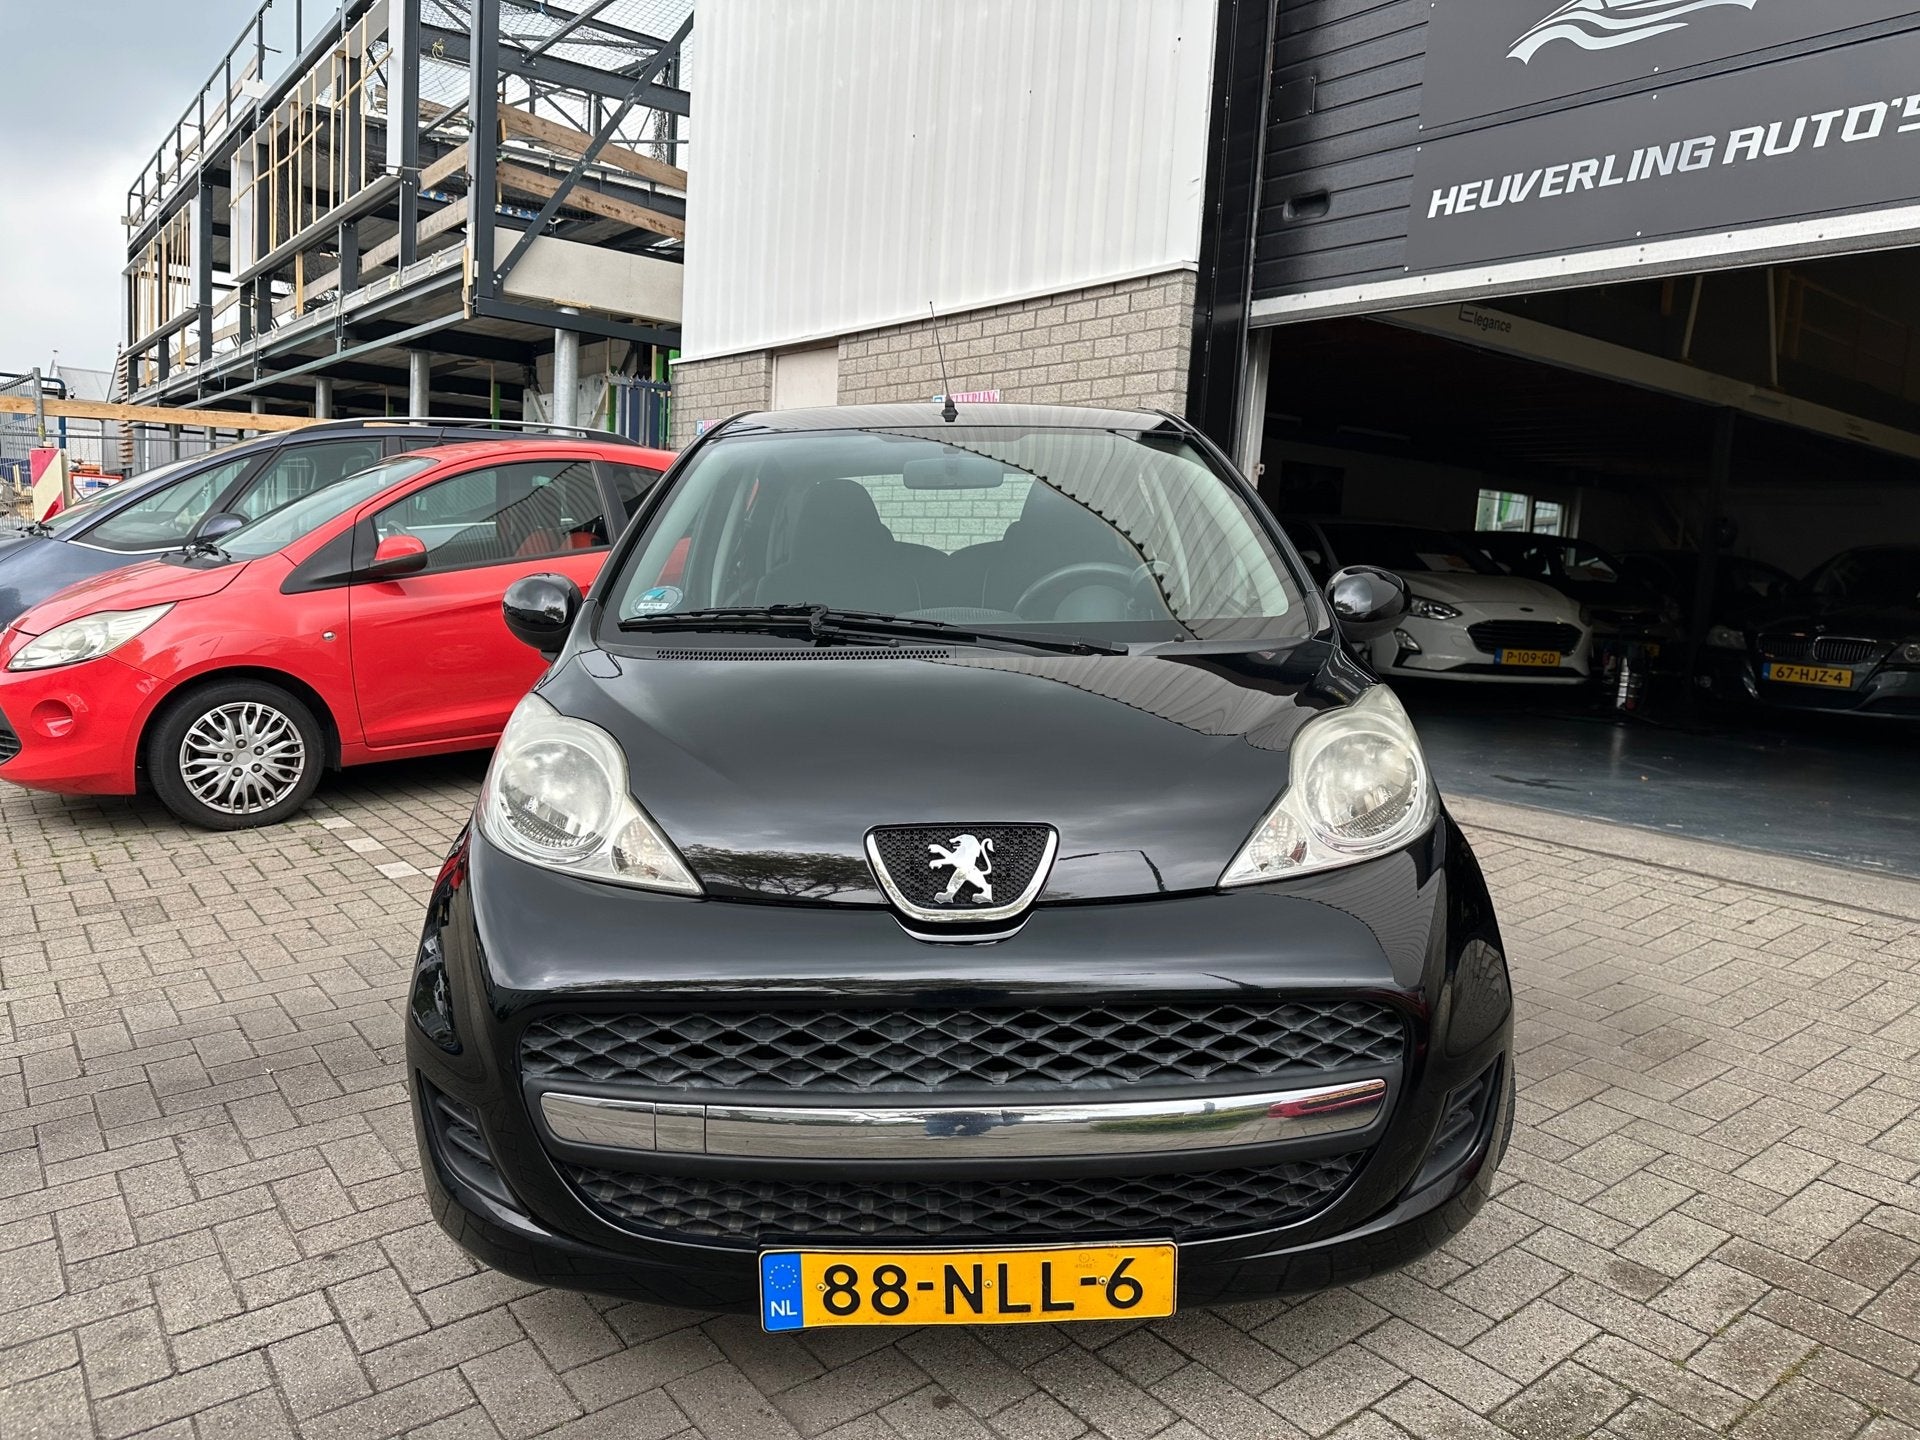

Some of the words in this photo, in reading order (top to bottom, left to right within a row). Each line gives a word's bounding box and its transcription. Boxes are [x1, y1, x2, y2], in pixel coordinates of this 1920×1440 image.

[1427, 135, 1716, 219] HEUVERLING
[1506, 651, 1556, 664] P-109-GD
[1776, 666, 1843, 684] 67-HJZ-4
[770, 1300, 798, 1317] NL
[823, 1257, 1144, 1317] 88-NLL-6
